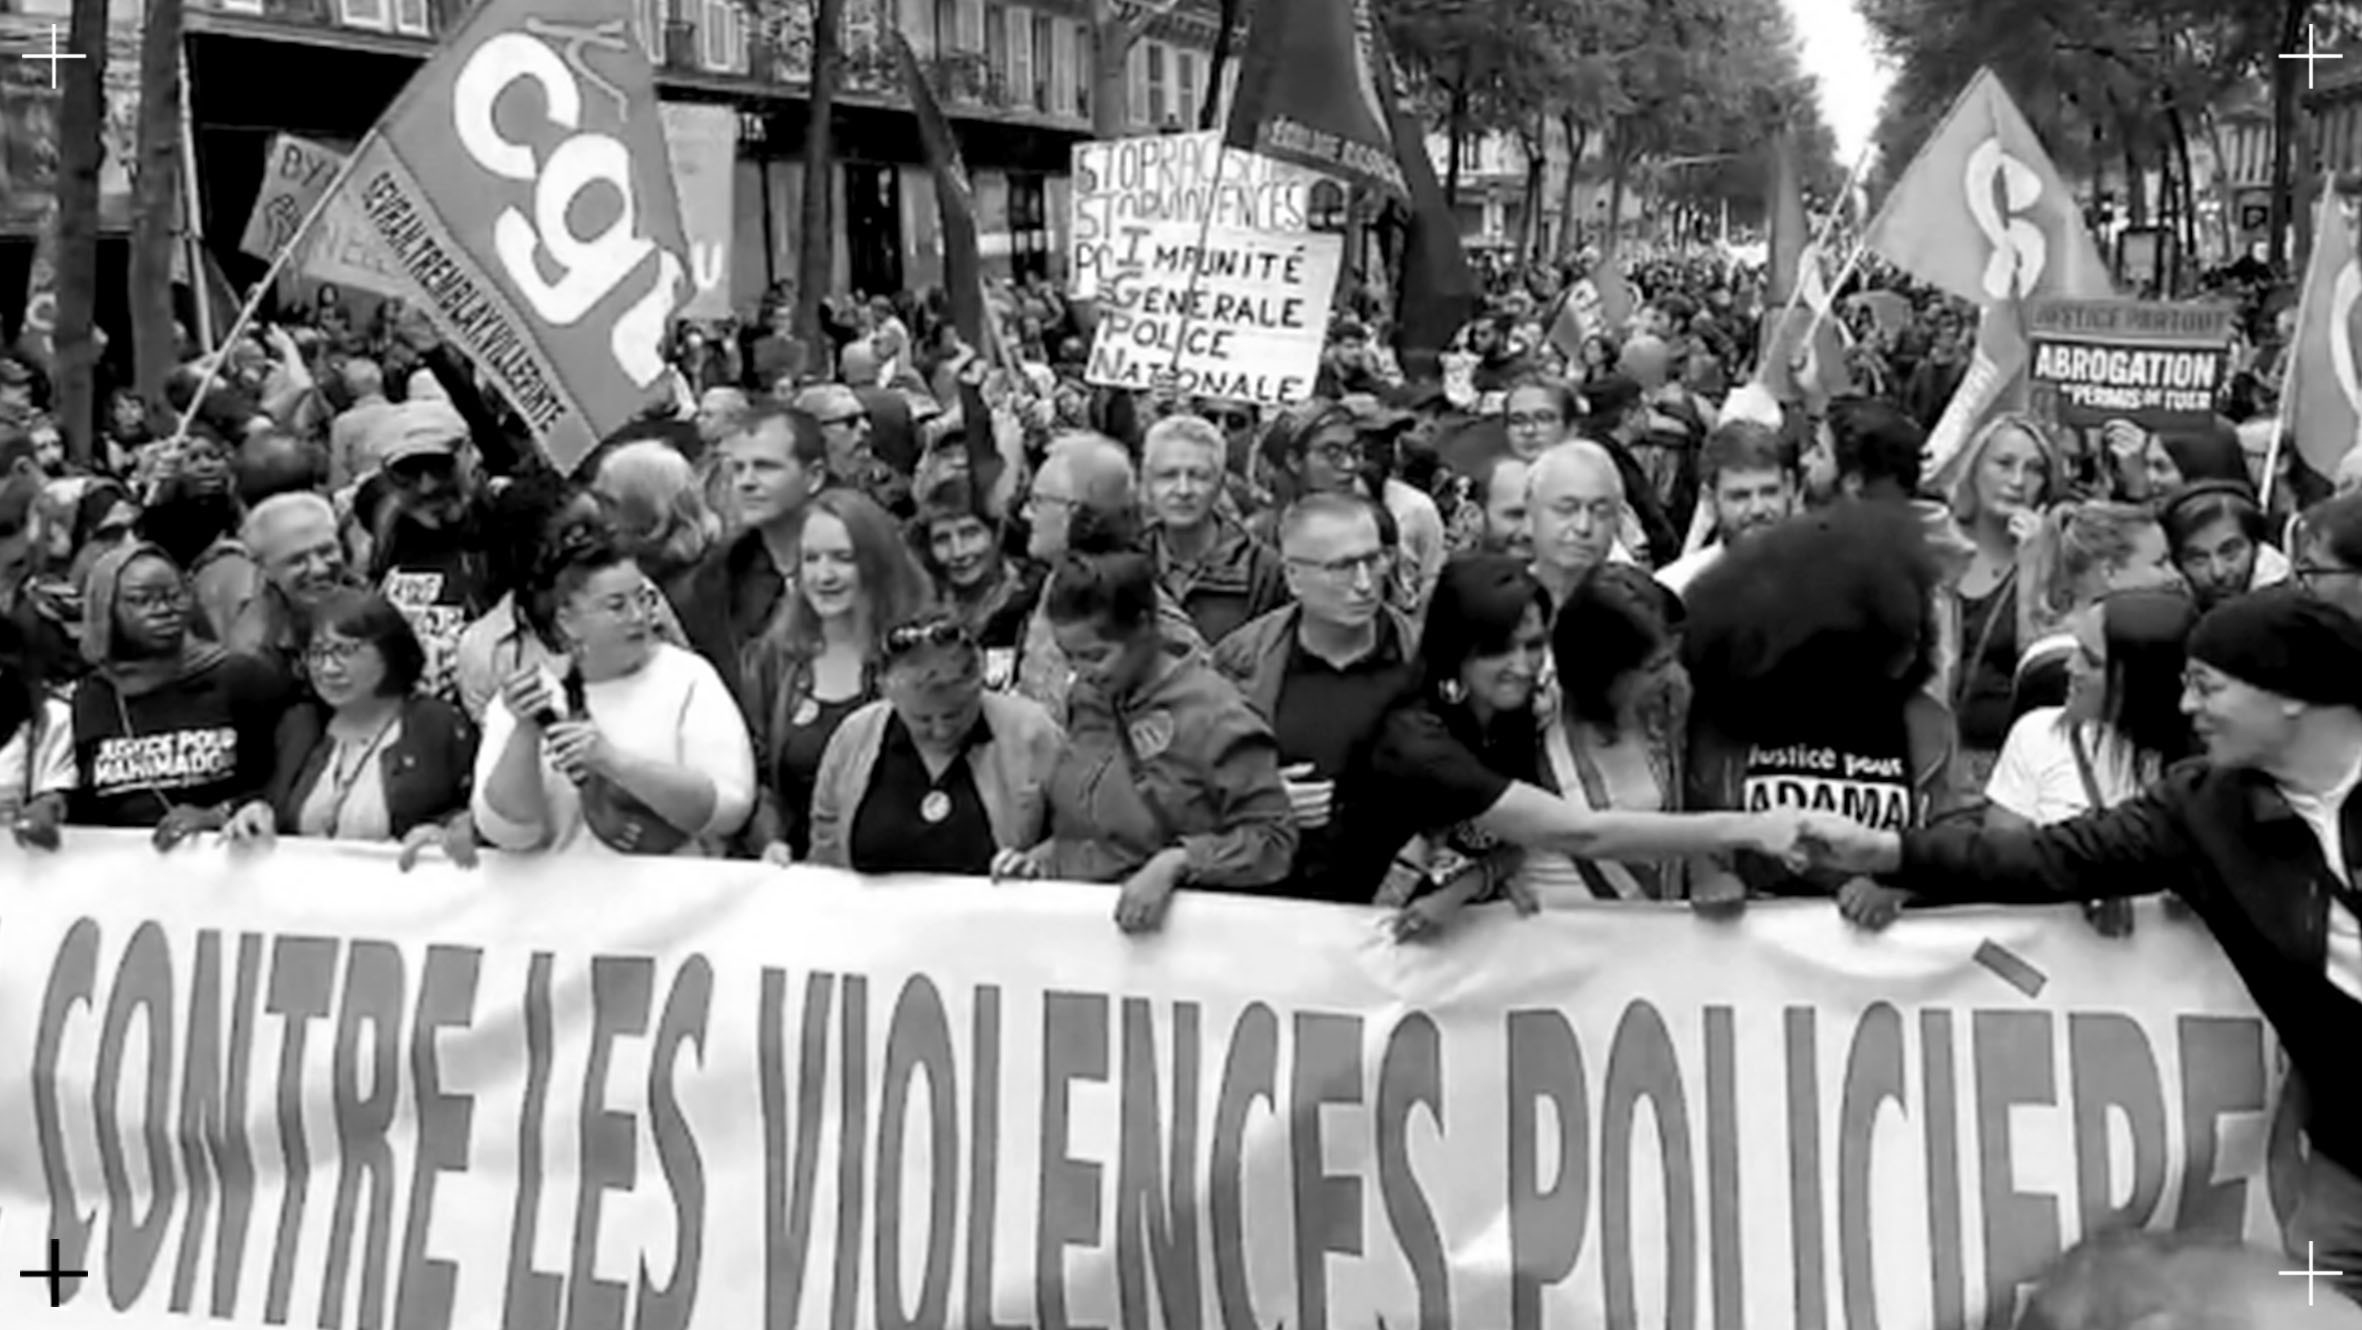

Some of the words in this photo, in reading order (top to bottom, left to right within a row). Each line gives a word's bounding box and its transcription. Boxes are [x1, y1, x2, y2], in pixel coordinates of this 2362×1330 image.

[1160, 182, 1304, 234] VIOENCES
[1117, 226, 1305, 284] IMPUNITÉ
[1100, 310, 1235, 359] POLCE
[1091, 348, 1303, 406] NATONALE
[2035, 344, 2216, 389] ABROGATION
[1750, 780, 1905, 832] ADAMA
[33, 916, 484, 1330] CONTRE
[502, 952, 714, 1330] LES
[758, 965, 1450, 1330] VIOLENCES
[1506, 937, 2290, 1330] POLICIÈRE
